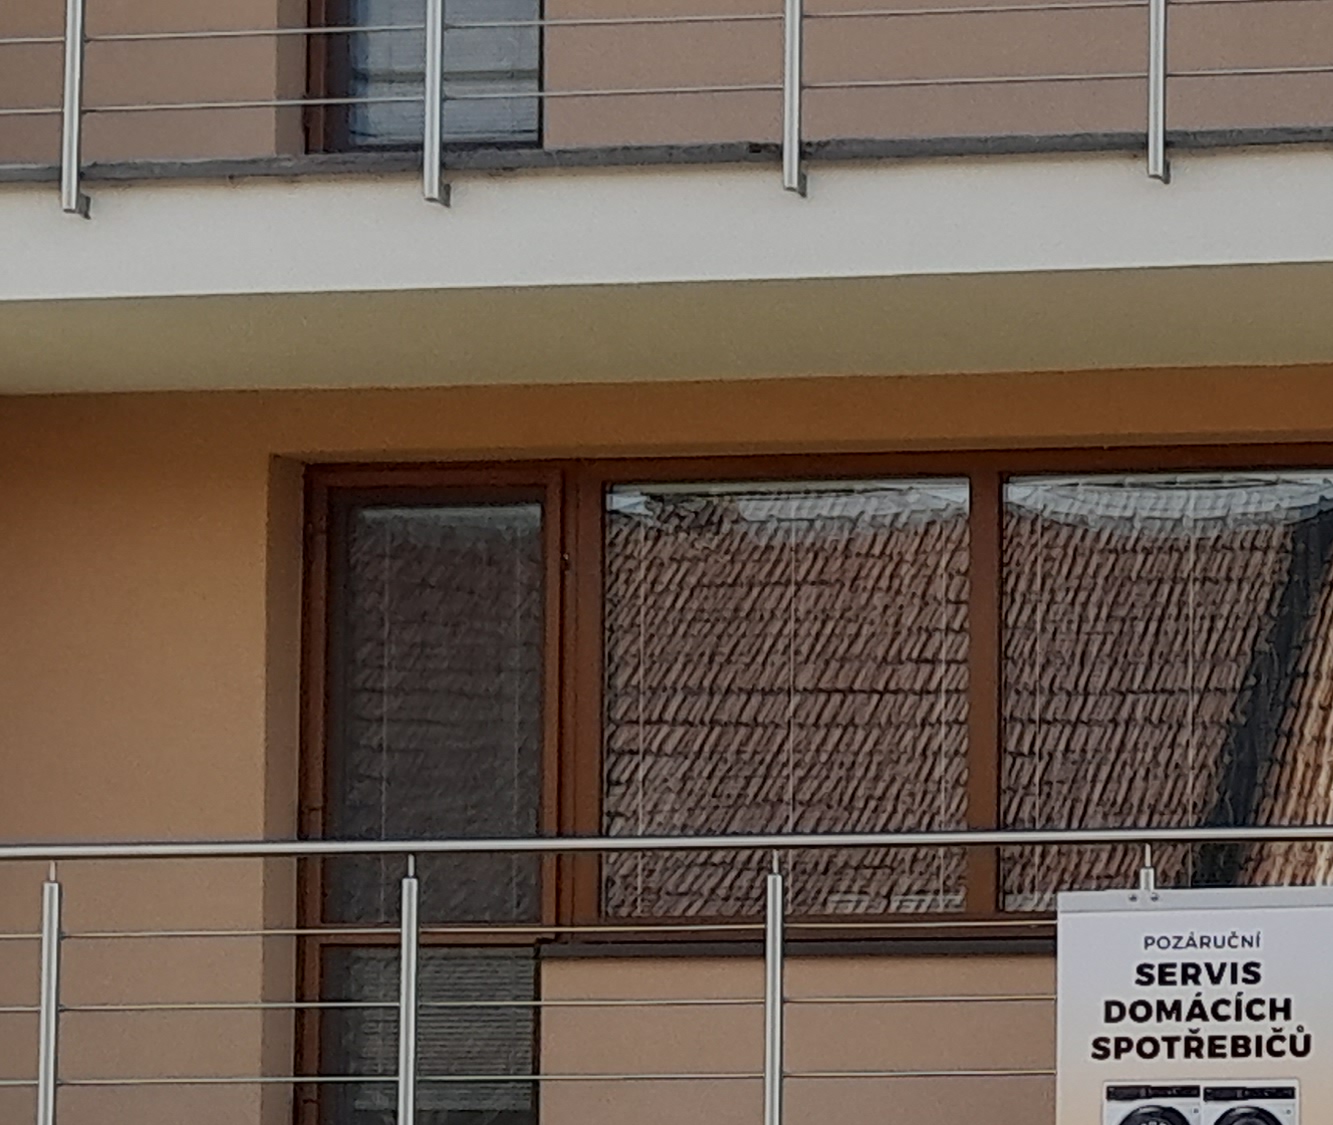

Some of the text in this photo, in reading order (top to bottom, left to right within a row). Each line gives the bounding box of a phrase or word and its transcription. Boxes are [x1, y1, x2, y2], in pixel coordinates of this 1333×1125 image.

[1144, 931, 1261, 950] POZÁRUČNÍ
[1134, 961, 1262, 987] SERVIS
[1104, 991, 1292, 1024] DOMÁCÍCH
[1091, 1024, 1312, 1061] SPOTŘEBIČŮ
